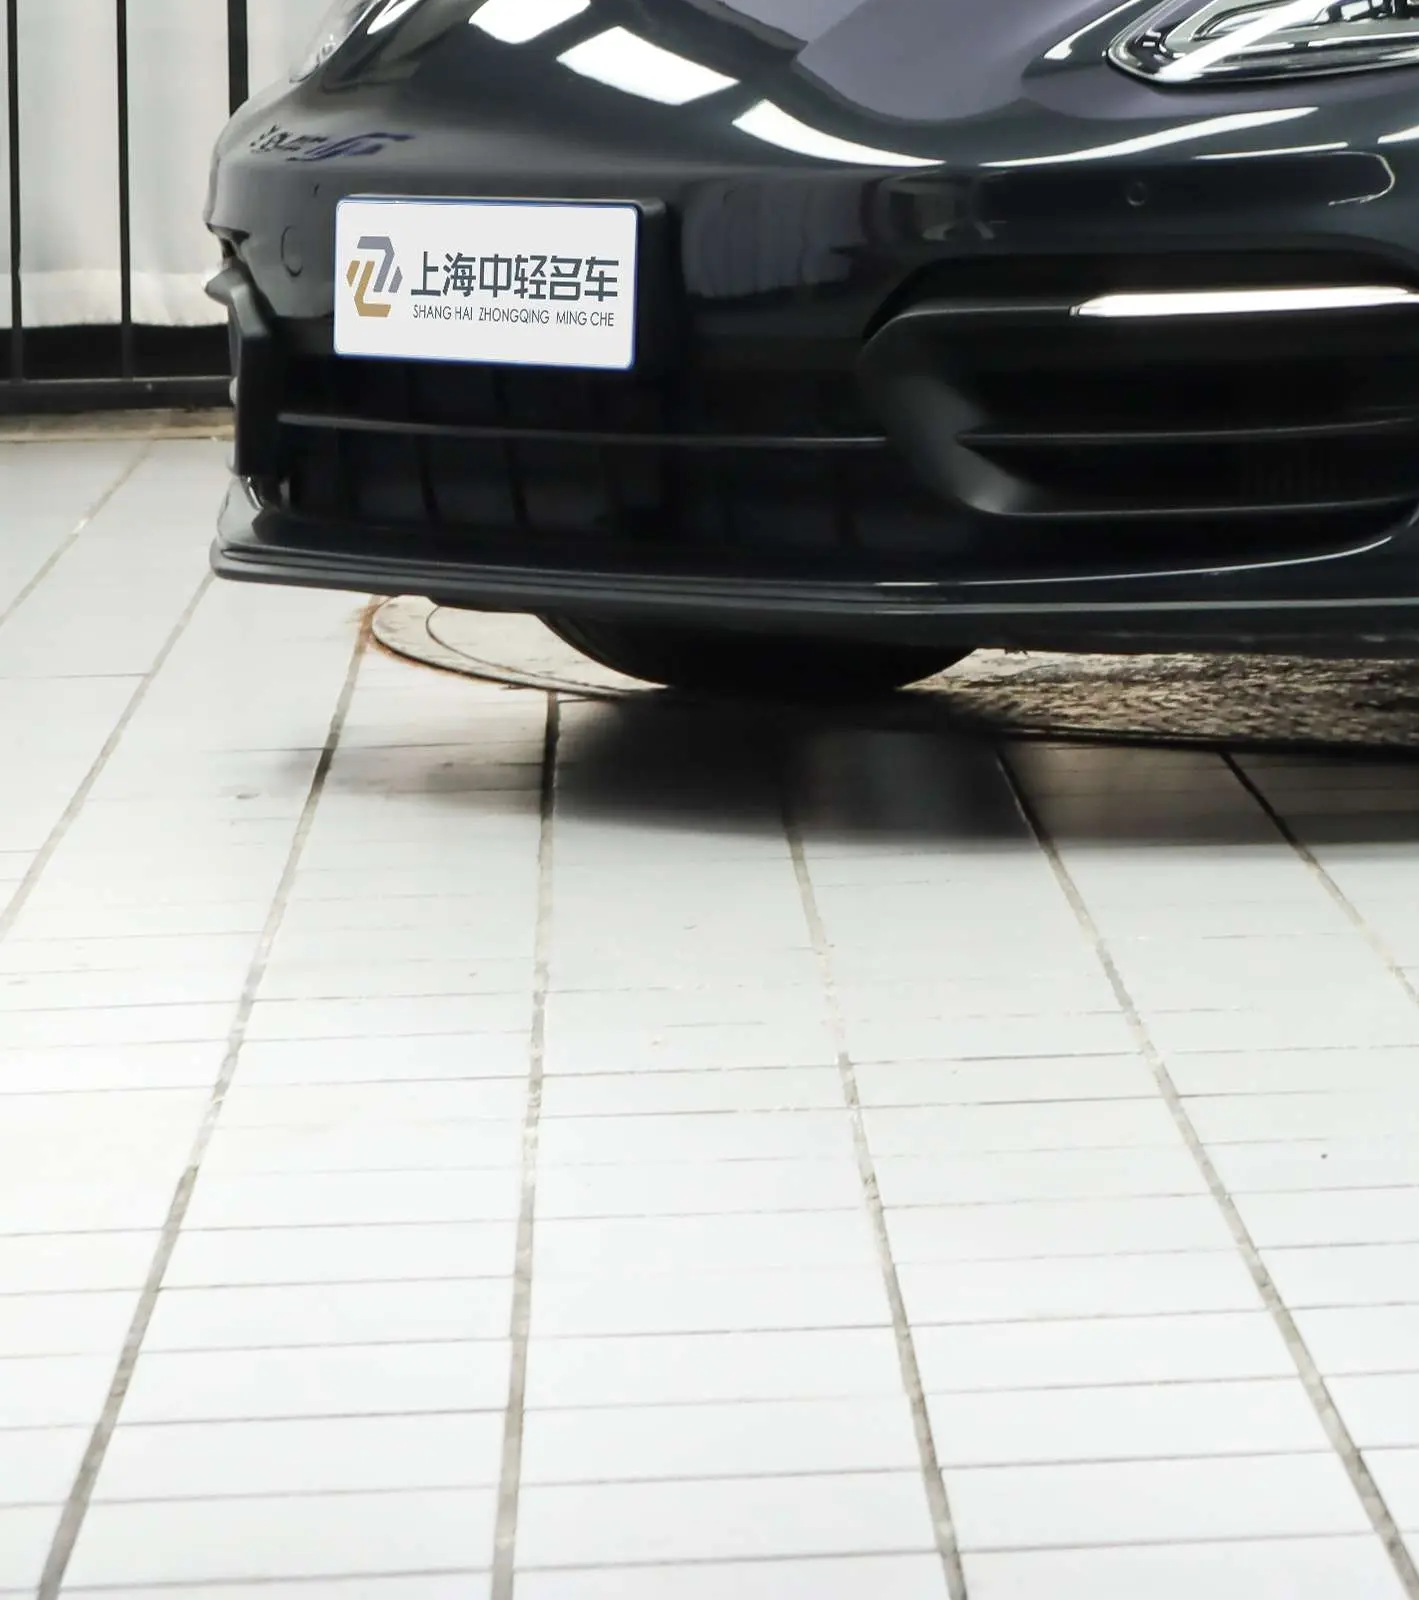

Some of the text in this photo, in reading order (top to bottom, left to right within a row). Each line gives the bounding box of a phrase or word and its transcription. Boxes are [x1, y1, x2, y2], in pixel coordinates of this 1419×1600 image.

[410, 251, 620, 302] 上海中轻名车
[412, 303, 615, 327] SHANG HAI ZHONGQING MING CHE
